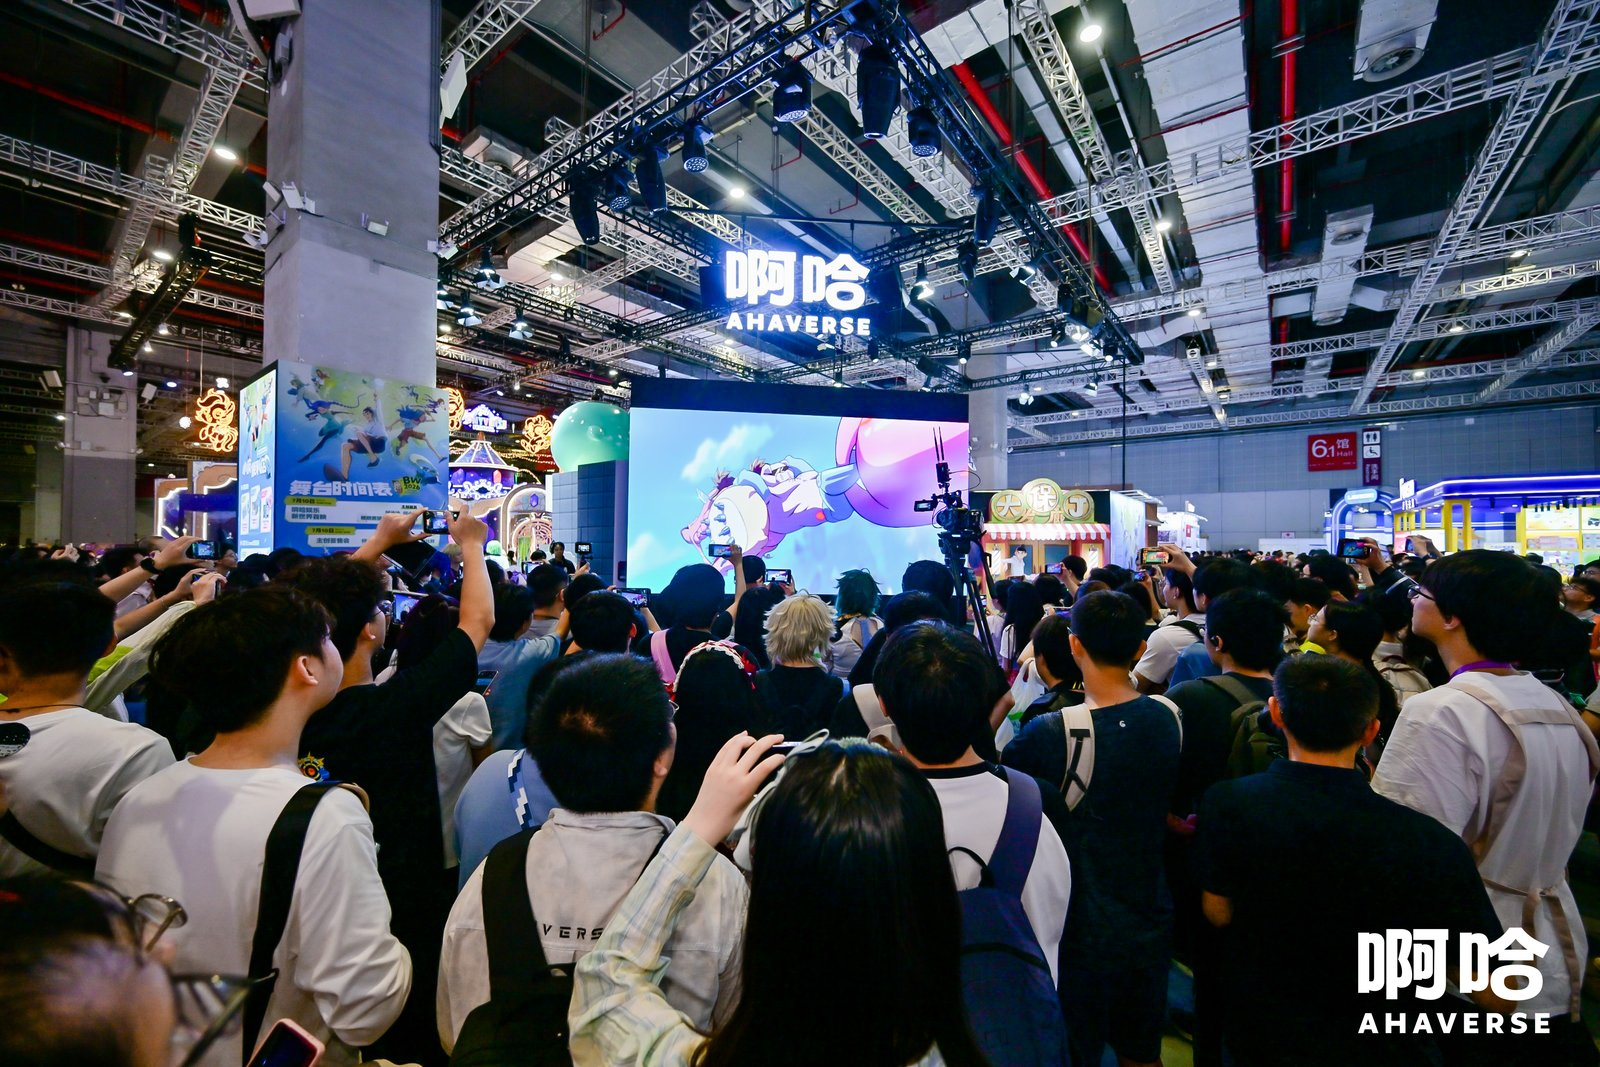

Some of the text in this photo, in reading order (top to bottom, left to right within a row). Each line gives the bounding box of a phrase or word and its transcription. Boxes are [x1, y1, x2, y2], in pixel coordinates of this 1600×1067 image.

[725, 250, 871, 311] 啊哈
[726, 312, 871, 336] AHAVERSE
[1336, 438, 1350, 449] 馆
[288, 480, 393, 496] 舞台时间表
[402, 476, 421, 484] BW
